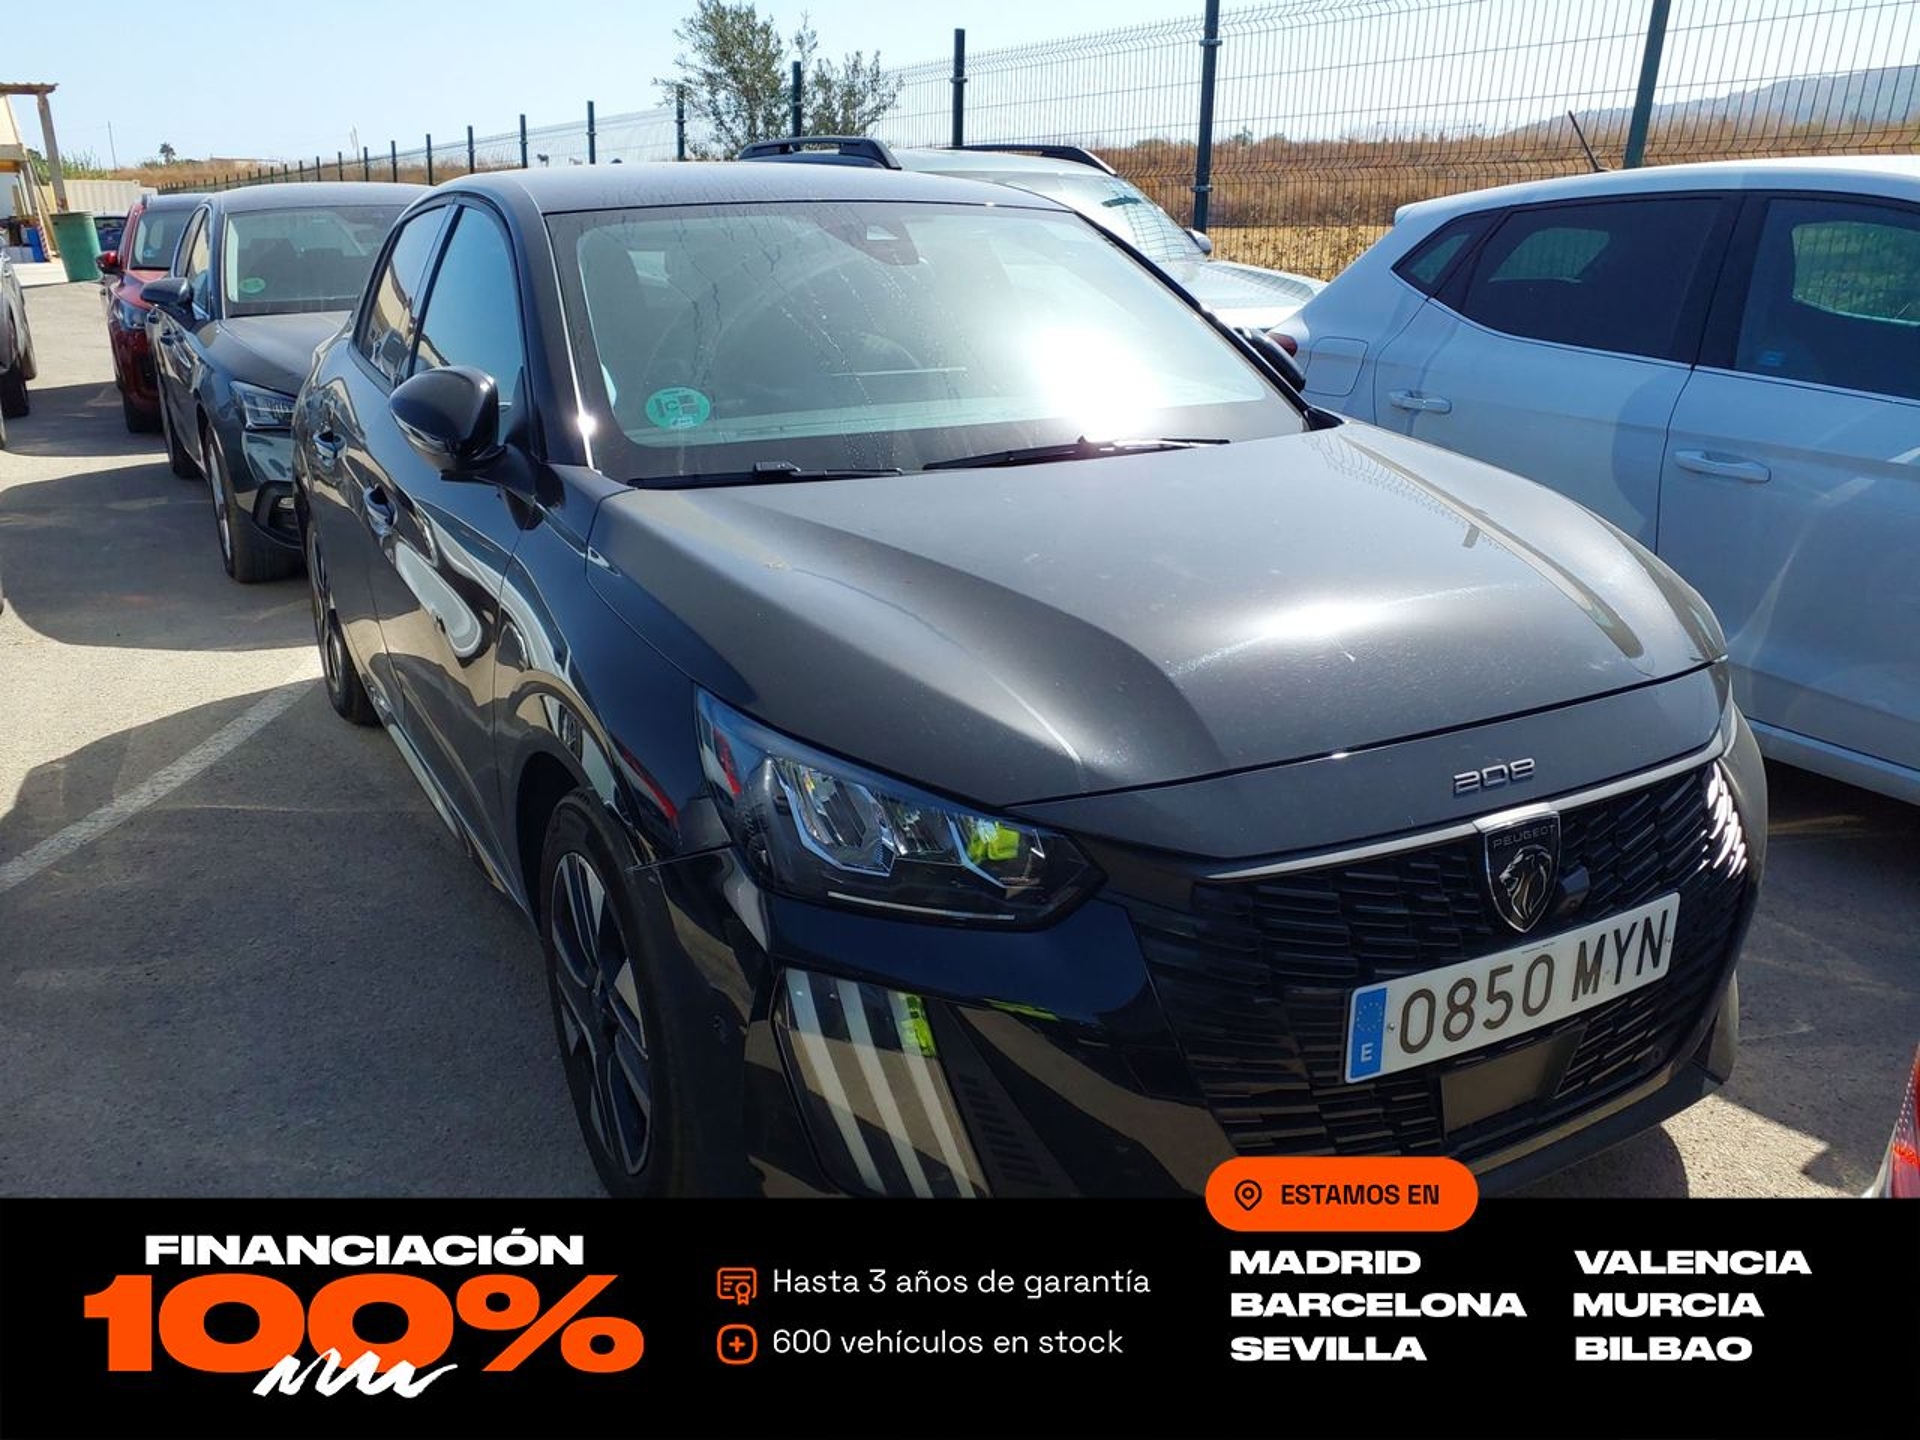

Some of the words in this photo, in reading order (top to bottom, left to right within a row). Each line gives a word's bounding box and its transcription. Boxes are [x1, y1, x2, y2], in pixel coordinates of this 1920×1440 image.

[1453, 757, 1536, 794] 208
[1493, 824, 1557, 848] PEUGEOT
[1400, 953, 1555, 1054] 0850
[1571, 909, 1669, 1002] MYN
[1360, 1042, 1374, 1063] E
